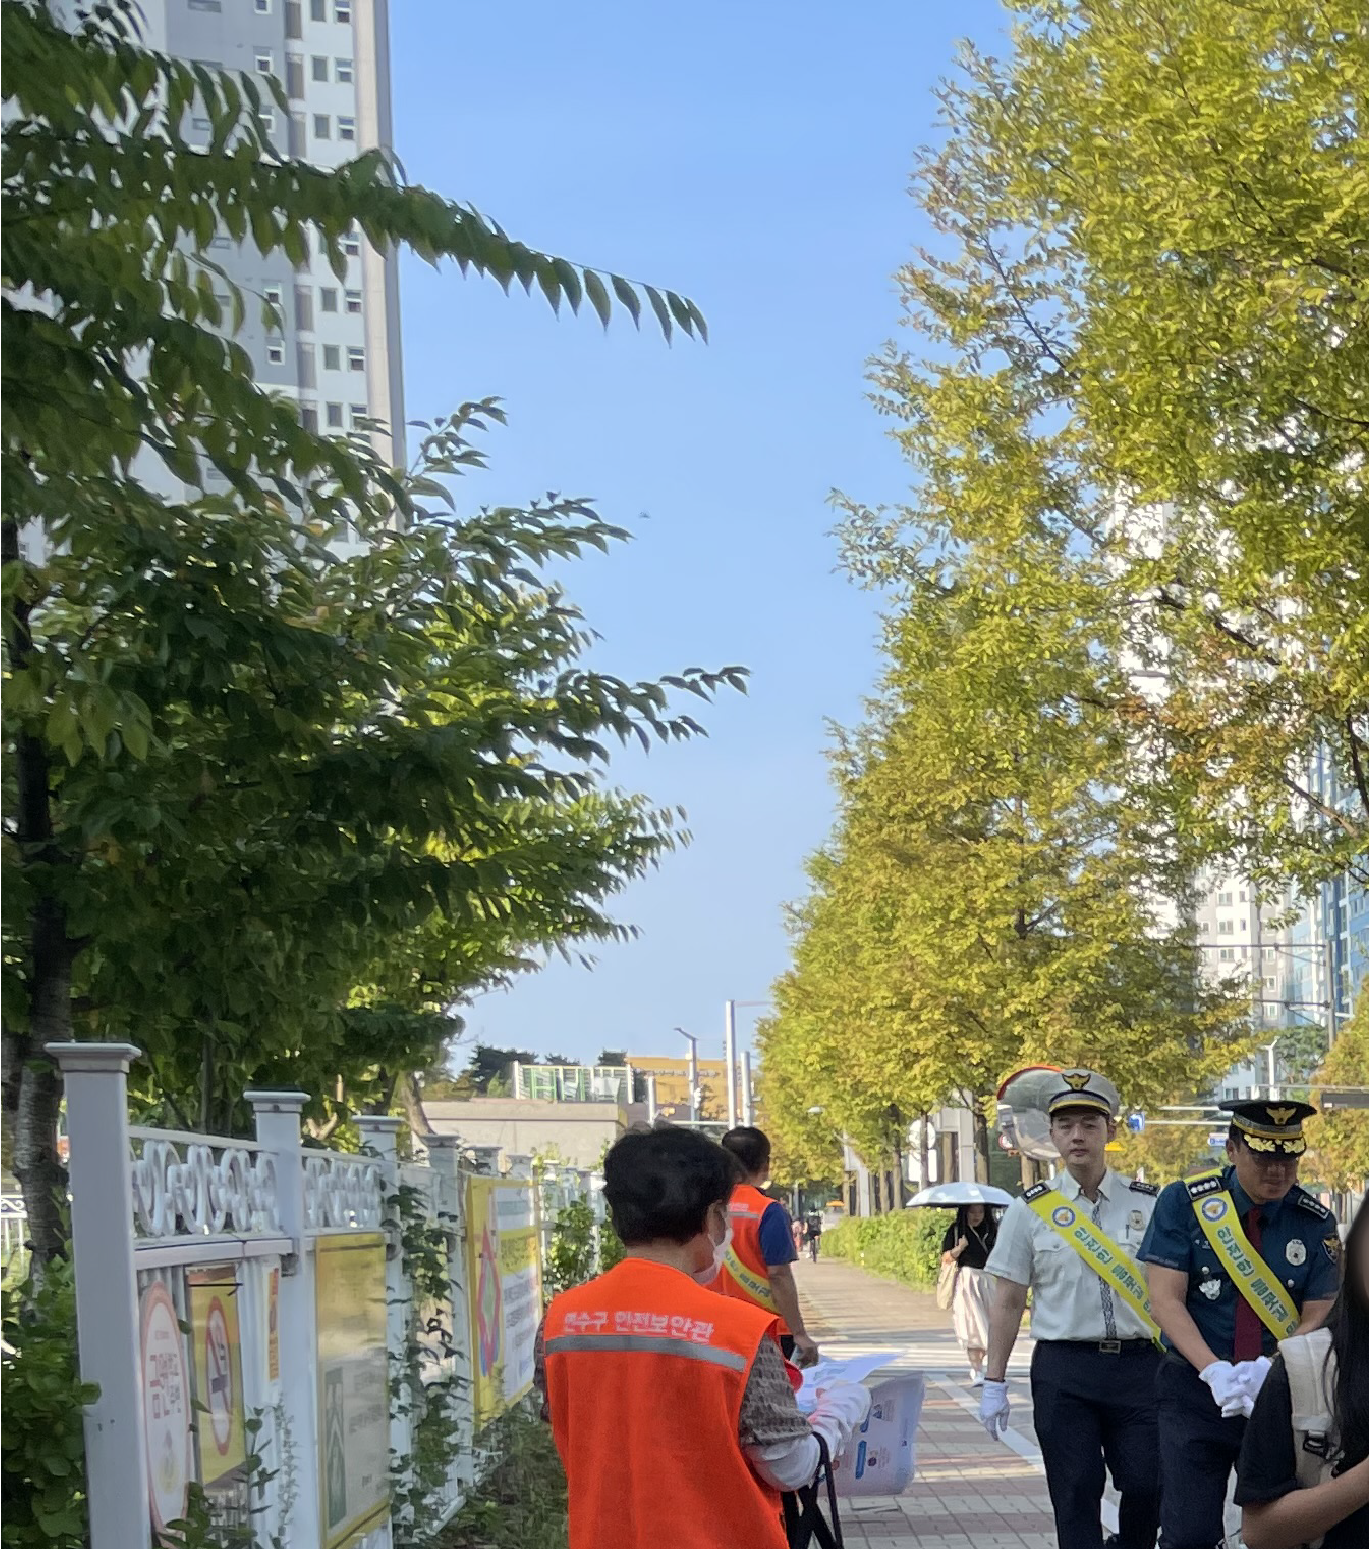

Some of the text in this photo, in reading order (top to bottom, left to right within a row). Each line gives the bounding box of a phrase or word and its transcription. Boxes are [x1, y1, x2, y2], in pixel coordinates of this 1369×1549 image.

[1074, 1226, 1114, 1266] 안전한
[1216, 1226, 1256, 1279] 안전한
[563, 1310, 609, 1333] 연수구
